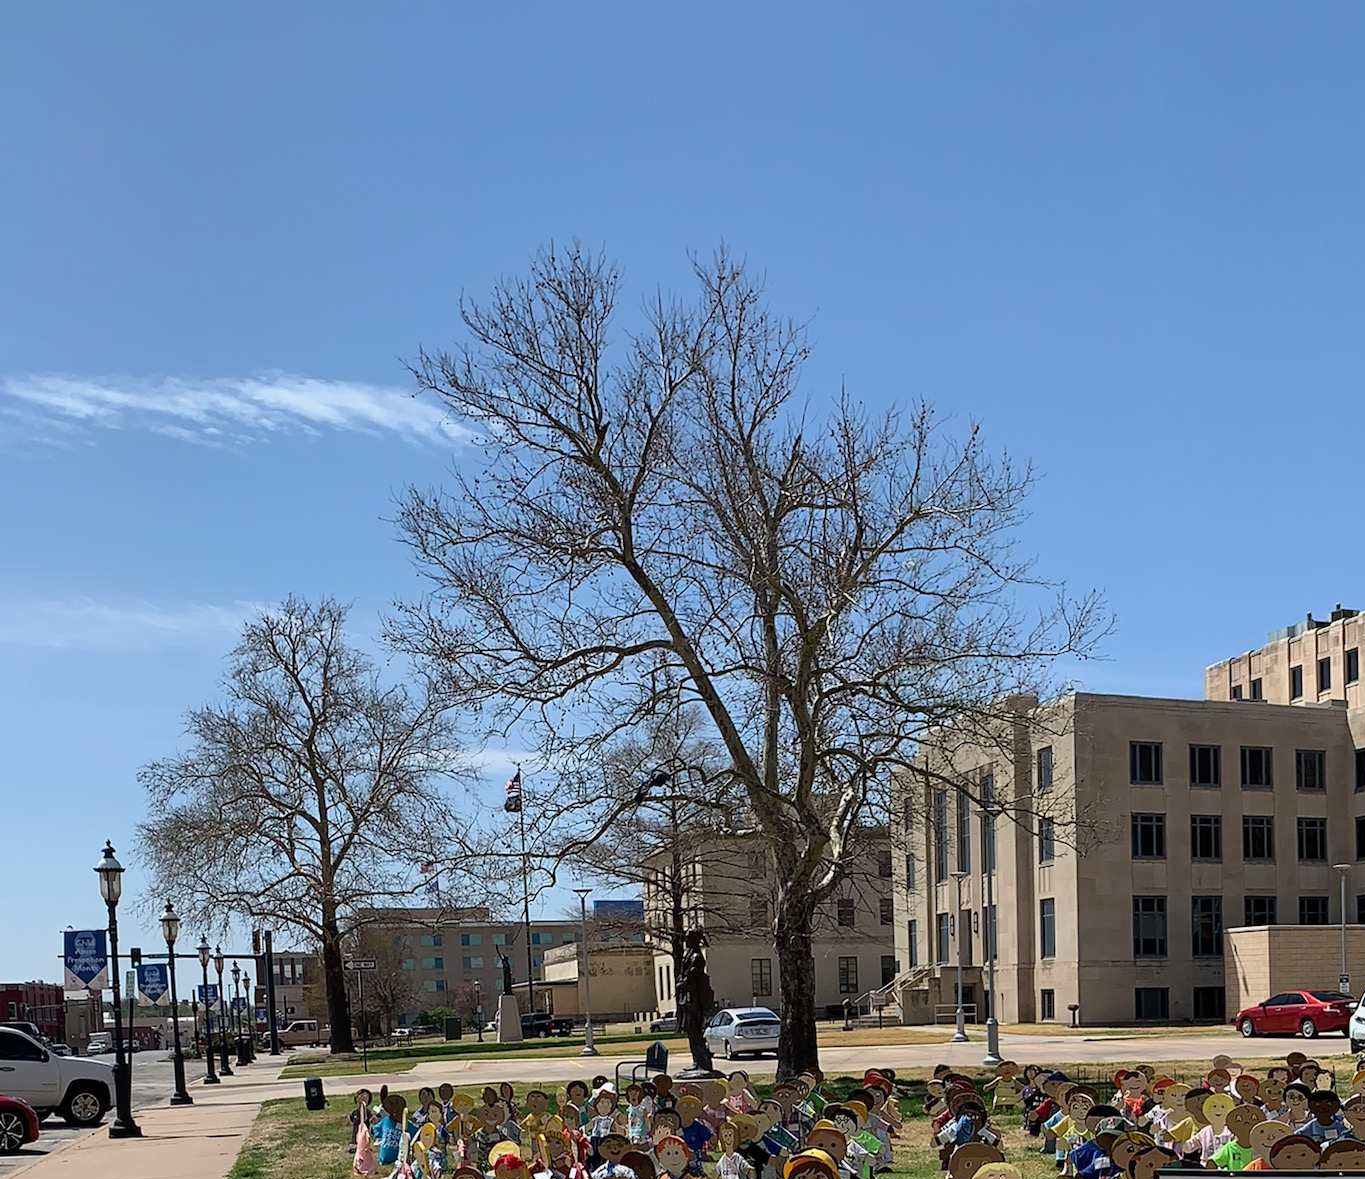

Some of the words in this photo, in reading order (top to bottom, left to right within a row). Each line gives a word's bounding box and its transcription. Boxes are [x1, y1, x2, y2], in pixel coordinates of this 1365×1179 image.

[76, 938, 95, 947] Child
[67, 956, 105, 964] Prevention
[75, 964, 97, 972] Month
